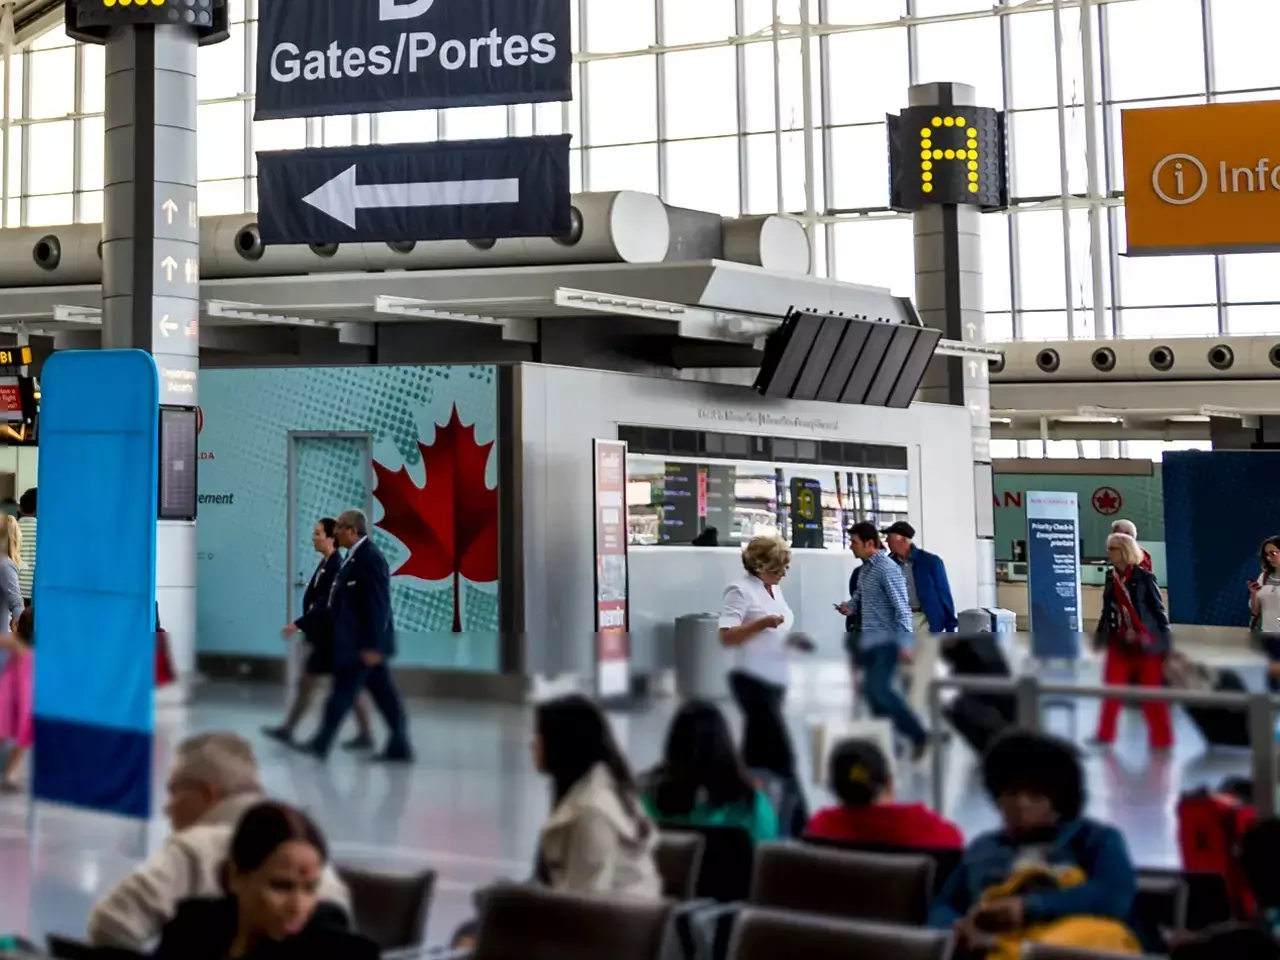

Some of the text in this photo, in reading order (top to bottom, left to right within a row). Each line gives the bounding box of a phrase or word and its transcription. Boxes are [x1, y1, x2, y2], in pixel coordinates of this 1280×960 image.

[270, 28, 557, 82] Gates/Portes
[920, 116, 979, 193] A
[0, 350, 13, 364] B1
